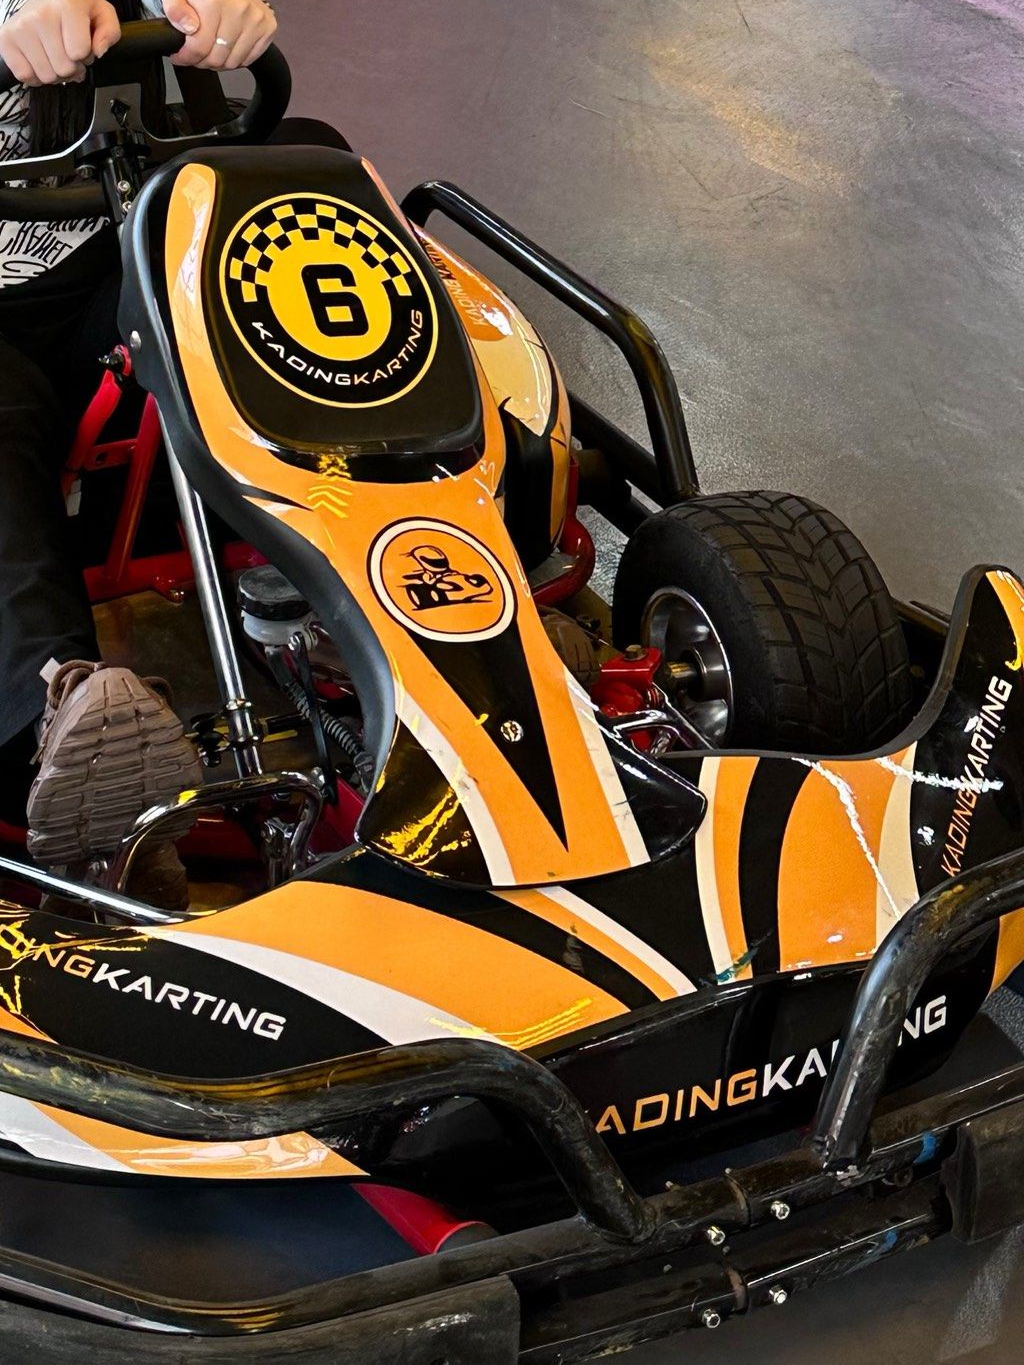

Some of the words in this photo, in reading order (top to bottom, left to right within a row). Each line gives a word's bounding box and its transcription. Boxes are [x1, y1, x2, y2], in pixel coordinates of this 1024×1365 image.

[300, 263, 370, 338] 6
[251, 308, 423, 386] KADINGKARTING
[940, 675, 1013, 878] KADINGKARTING
